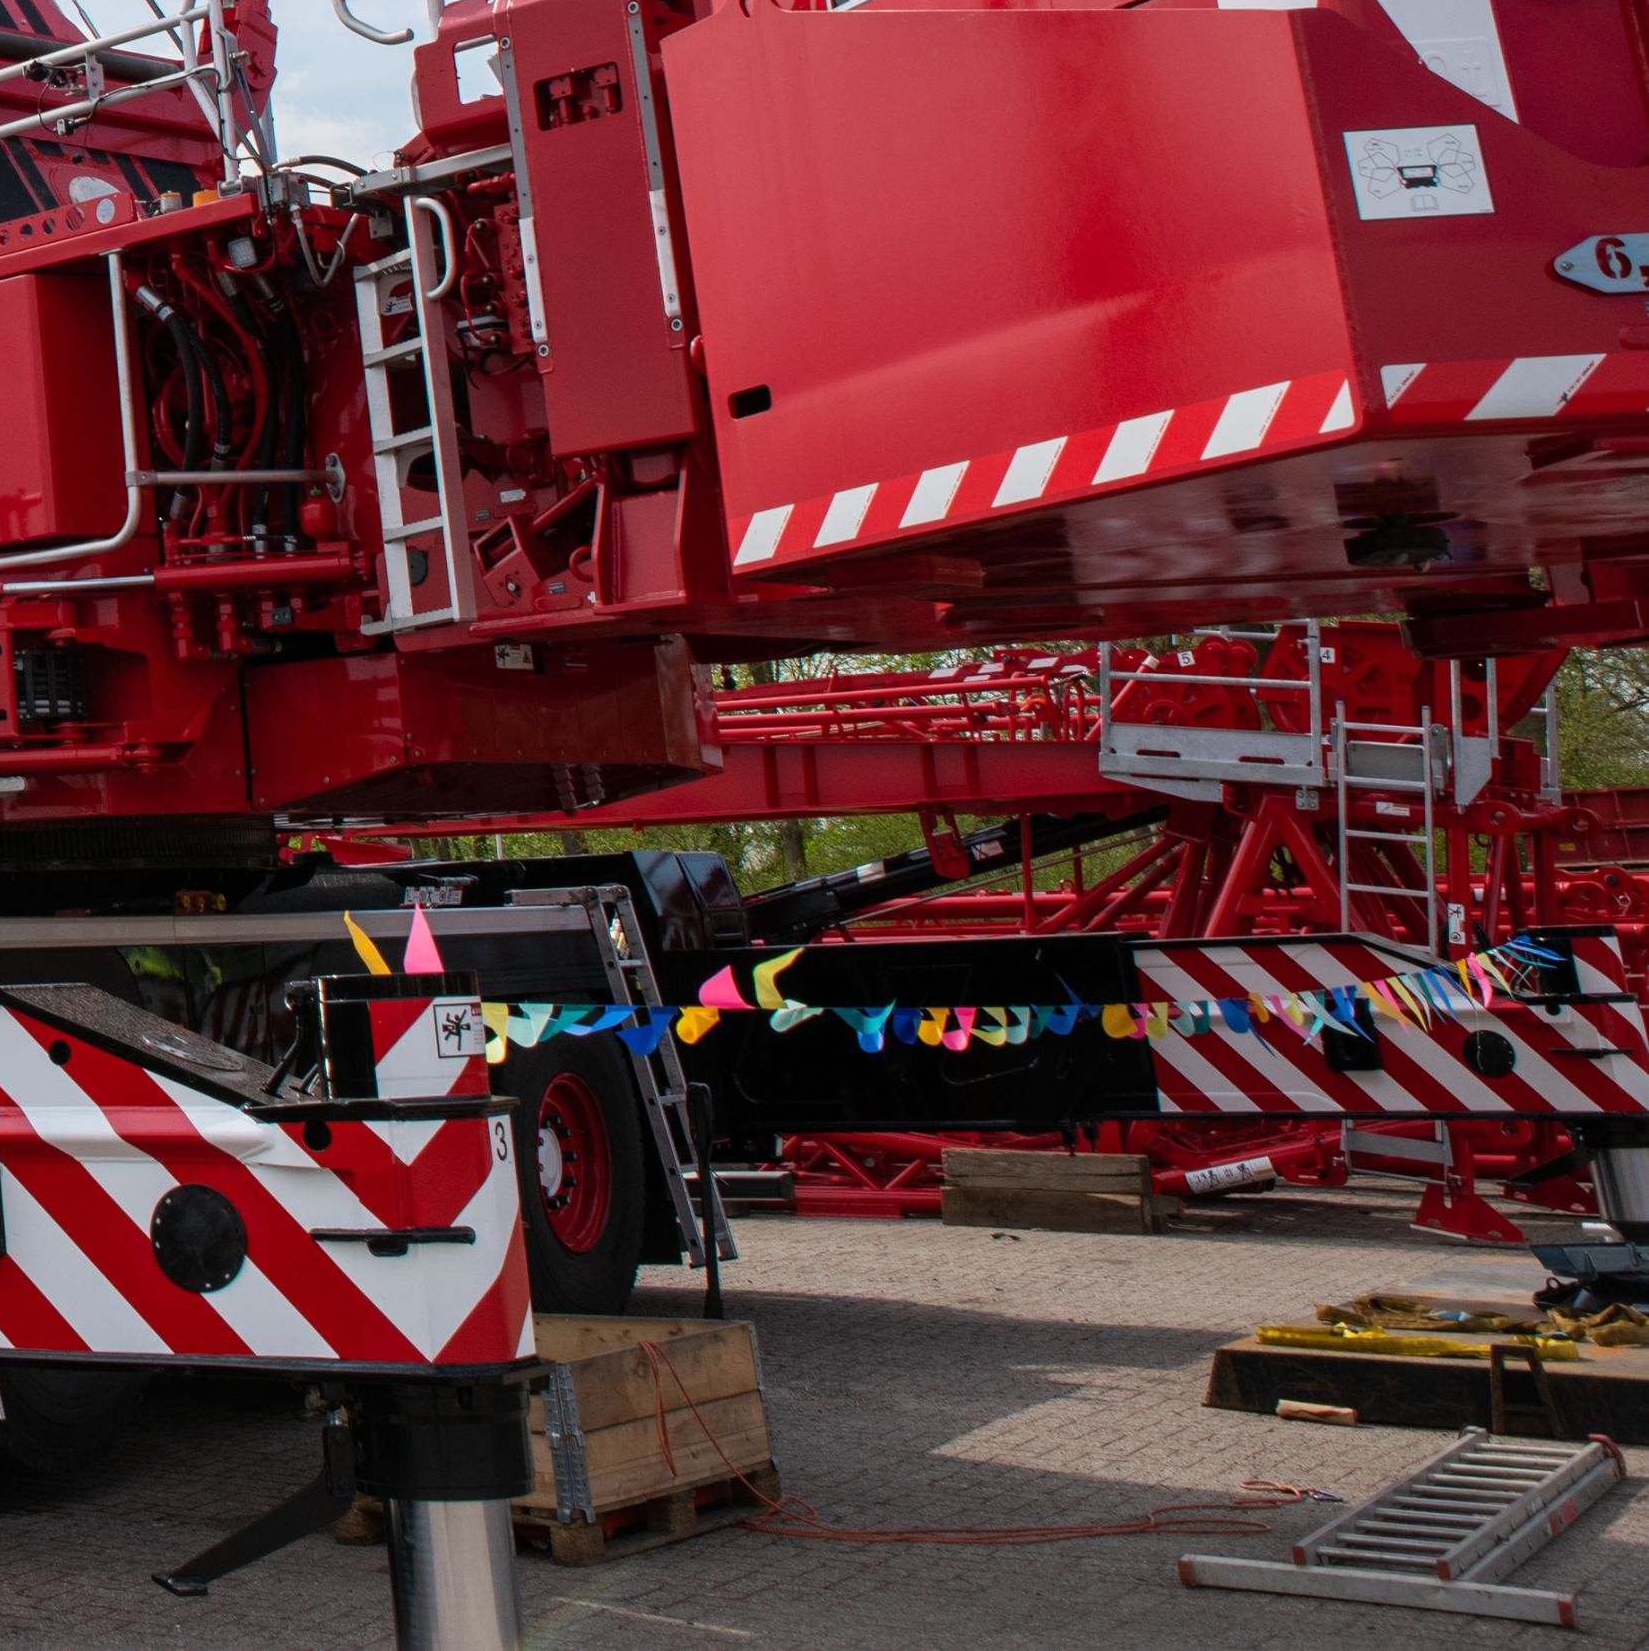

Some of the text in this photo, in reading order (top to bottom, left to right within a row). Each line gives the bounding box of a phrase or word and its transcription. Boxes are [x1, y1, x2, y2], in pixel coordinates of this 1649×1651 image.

[1182, 653, 1191, 664] 5
[1321, 650, 1330, 660] 4
[495, 1121, 507, 1161] 3
